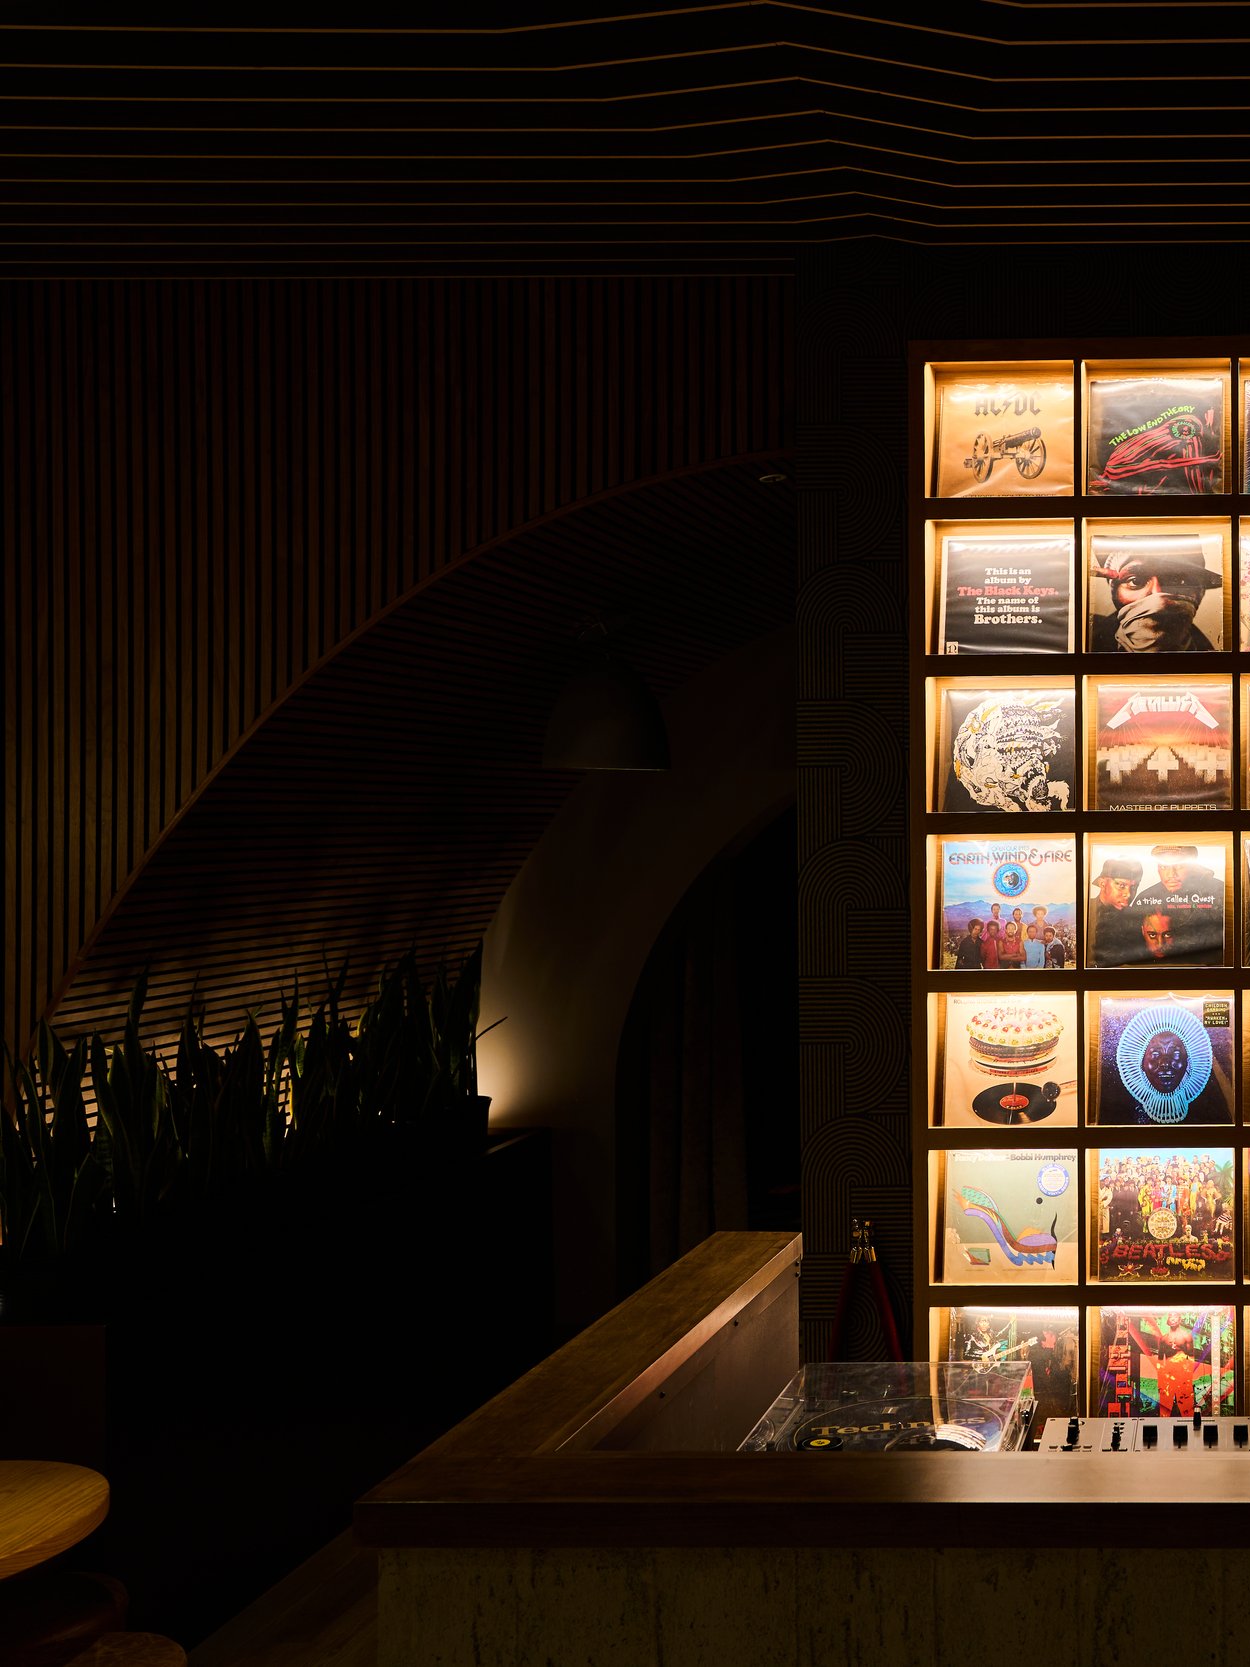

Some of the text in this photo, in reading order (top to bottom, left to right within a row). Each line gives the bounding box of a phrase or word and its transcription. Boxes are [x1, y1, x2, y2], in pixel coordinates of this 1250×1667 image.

[975, 391, 1042, 416] AC/DC
[1109, 405, 1196, 446] THE LOW END THEORY
[985, 567, 1008, 576] This
[1009, 567, 1018, 576] is
[985, 576, 1032, 586] album by
[957, 585, 1060, 597] The Black Keys.
[976, 597, 997, 605] The
[1028, 596, 1040, 605] of
[975, 605, 1041, 614] this album is
[974, 613, 1043, 625] Brothers.
[1106, 691, 1220, 730] METALLICA
[1170, 803, 1217, 811] PUPPETS
[992, 850, 1028, 863] WIND
[1044, 850, 1073, 862] FIRE
[1143, 897, 1162, 905] tribe
[1166, 894, 1189, 903] called
[1191, 893, 1216, 904] Quest
[1034, 1153, 1076, 1162] Humphrey
[1112, 1243, 1214, 1260] BEATLES
